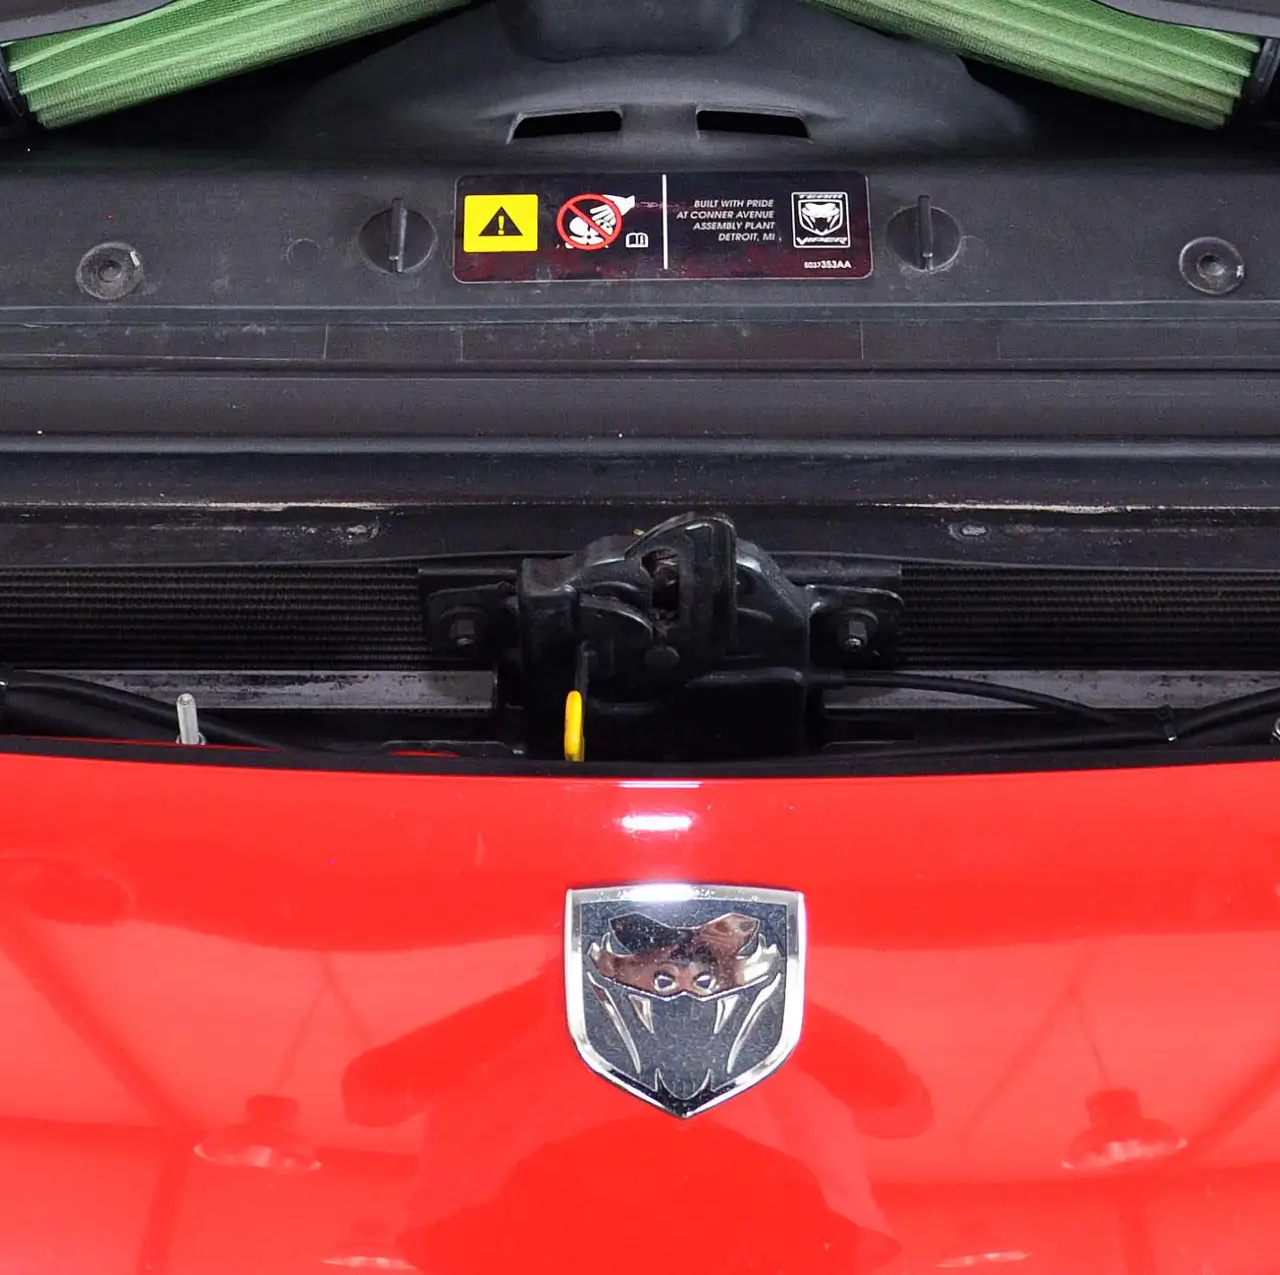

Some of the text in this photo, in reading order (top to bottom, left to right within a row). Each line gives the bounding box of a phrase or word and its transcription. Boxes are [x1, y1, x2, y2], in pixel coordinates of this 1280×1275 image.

[694, 199, 775, 208] BUILT WITH PRIDE
[676, 210, 775, 219] AT CONNER AVENUE
[693, 221, 776, 230] ASSEMBLY PLANT
[718, 232, 776, 242] DETROIT, MI
